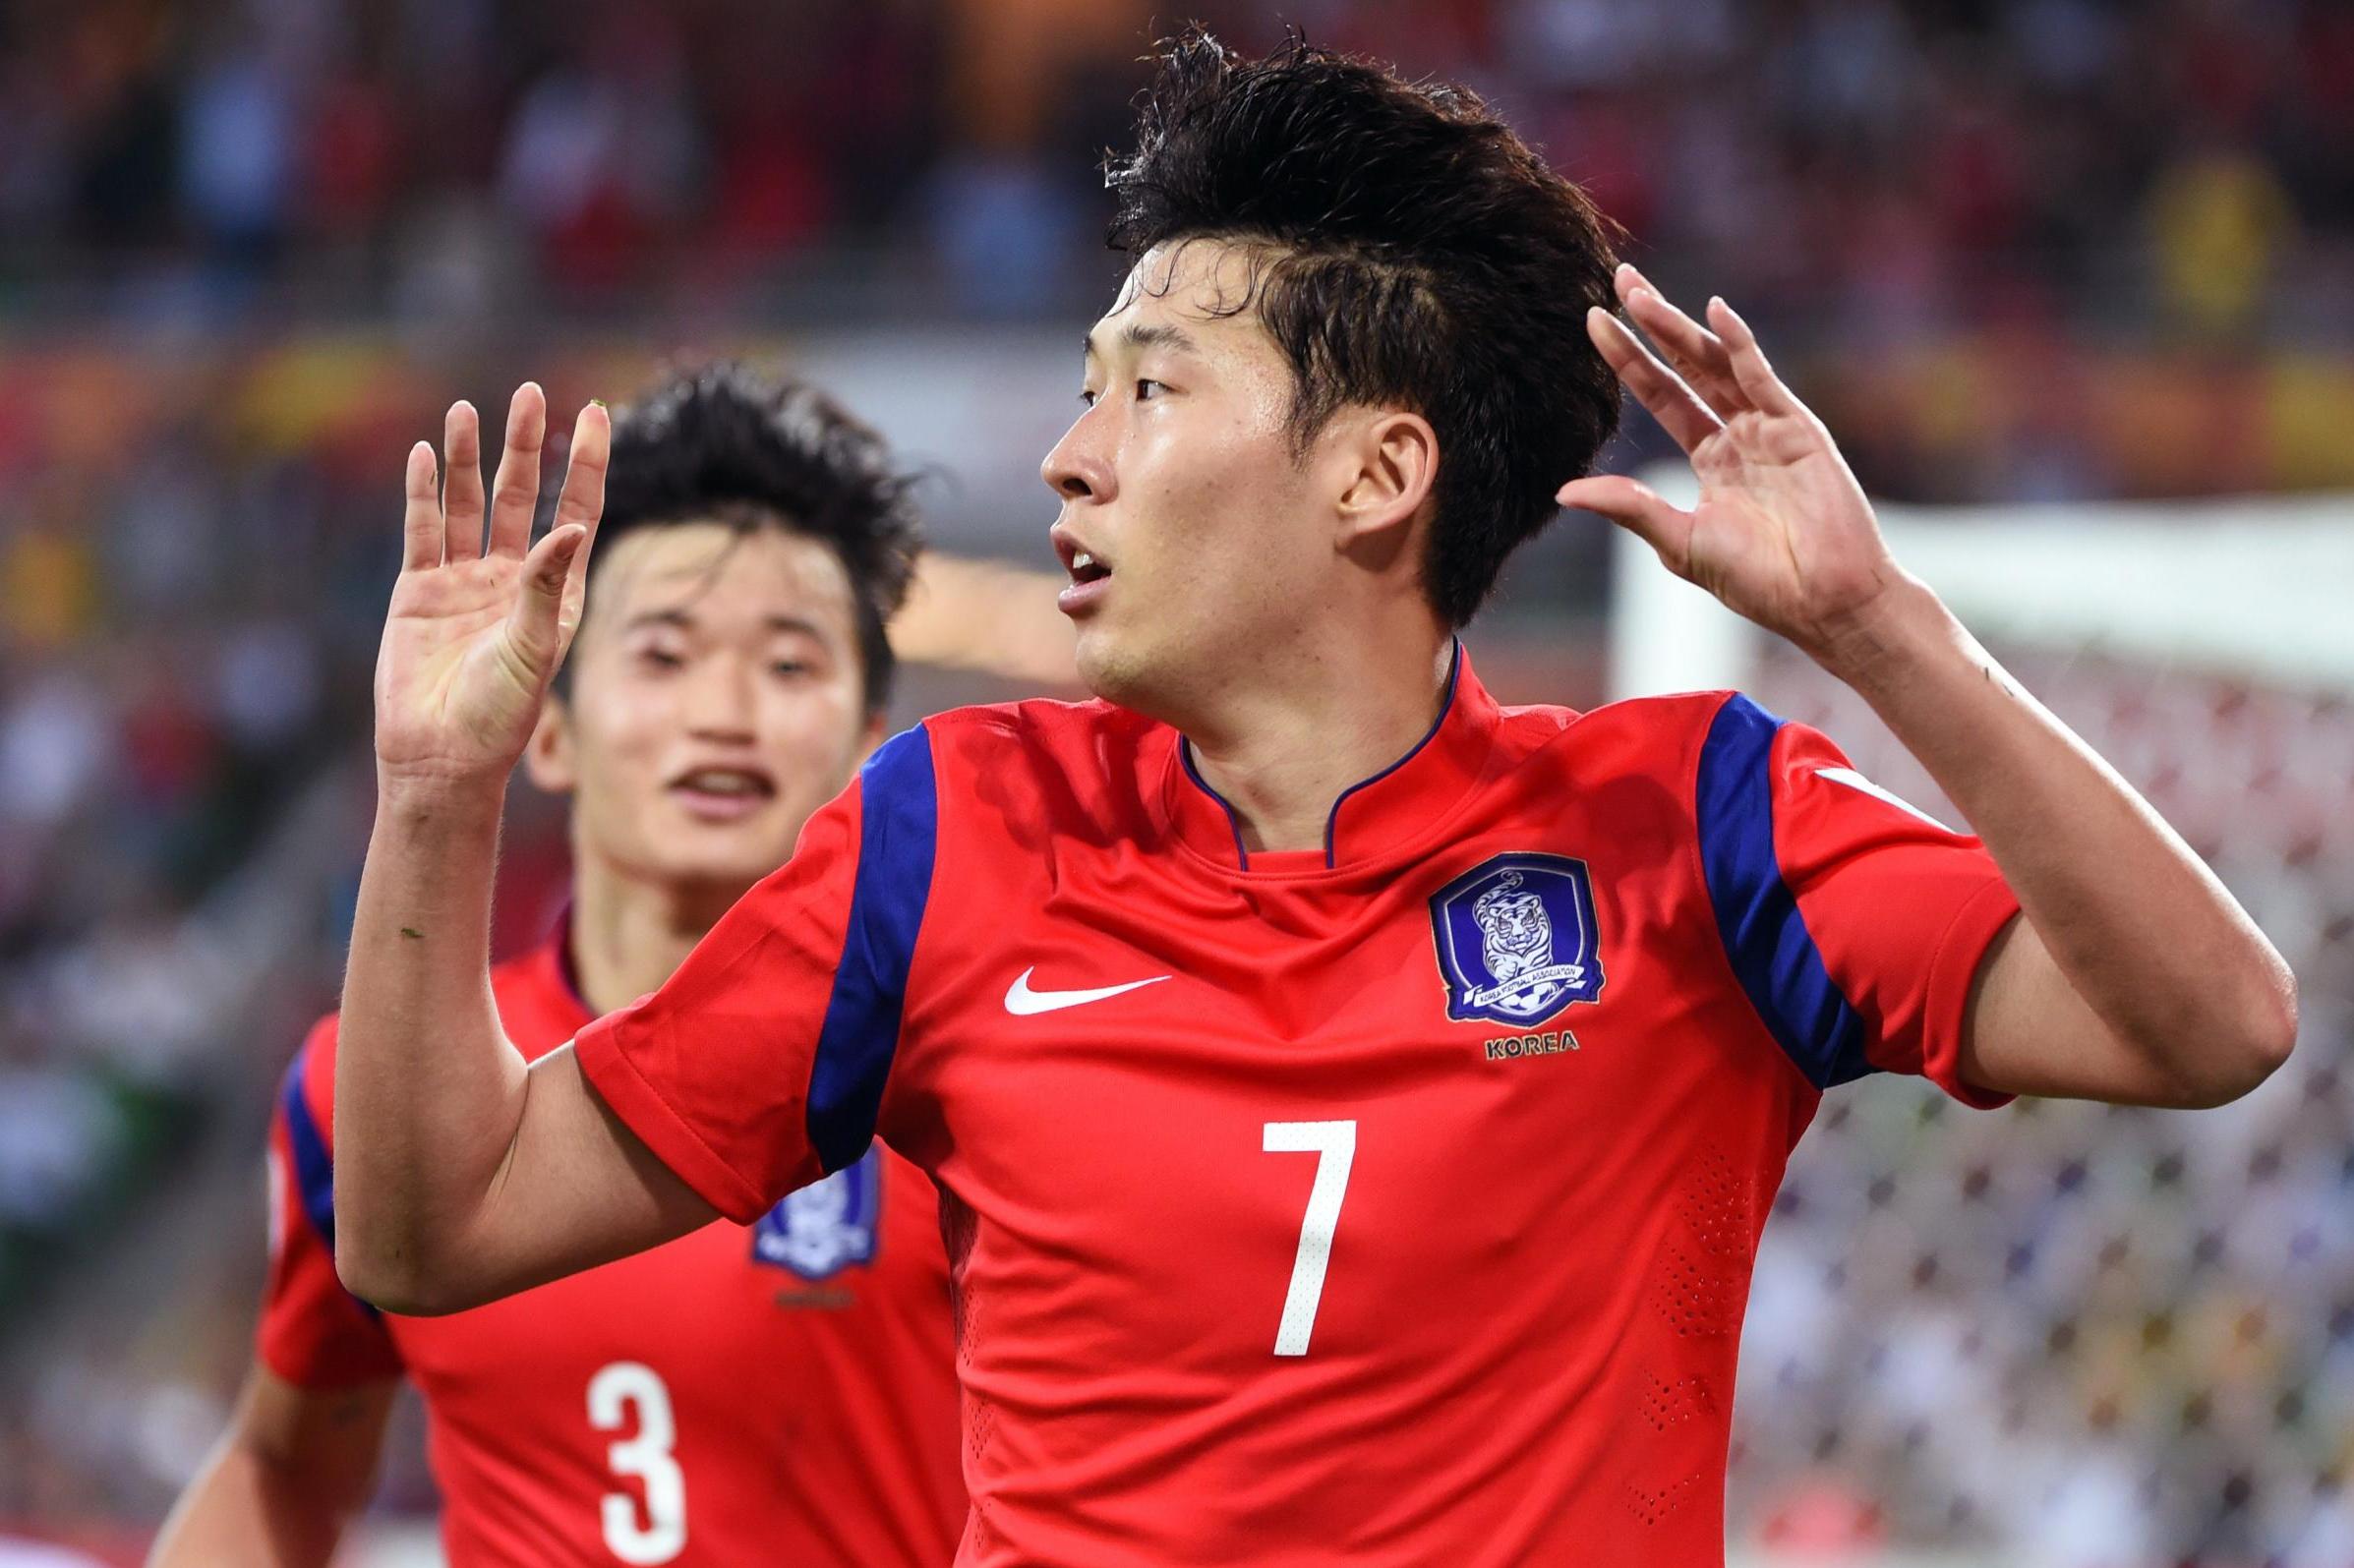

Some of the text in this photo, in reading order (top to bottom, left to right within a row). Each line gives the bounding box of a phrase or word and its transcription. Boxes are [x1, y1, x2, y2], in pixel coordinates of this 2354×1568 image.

[1485, 1030, 1579, 1060] KOREA
[1263, 1120, 1357, 1357] 7
[586, 1361, 687, 1565] 3
